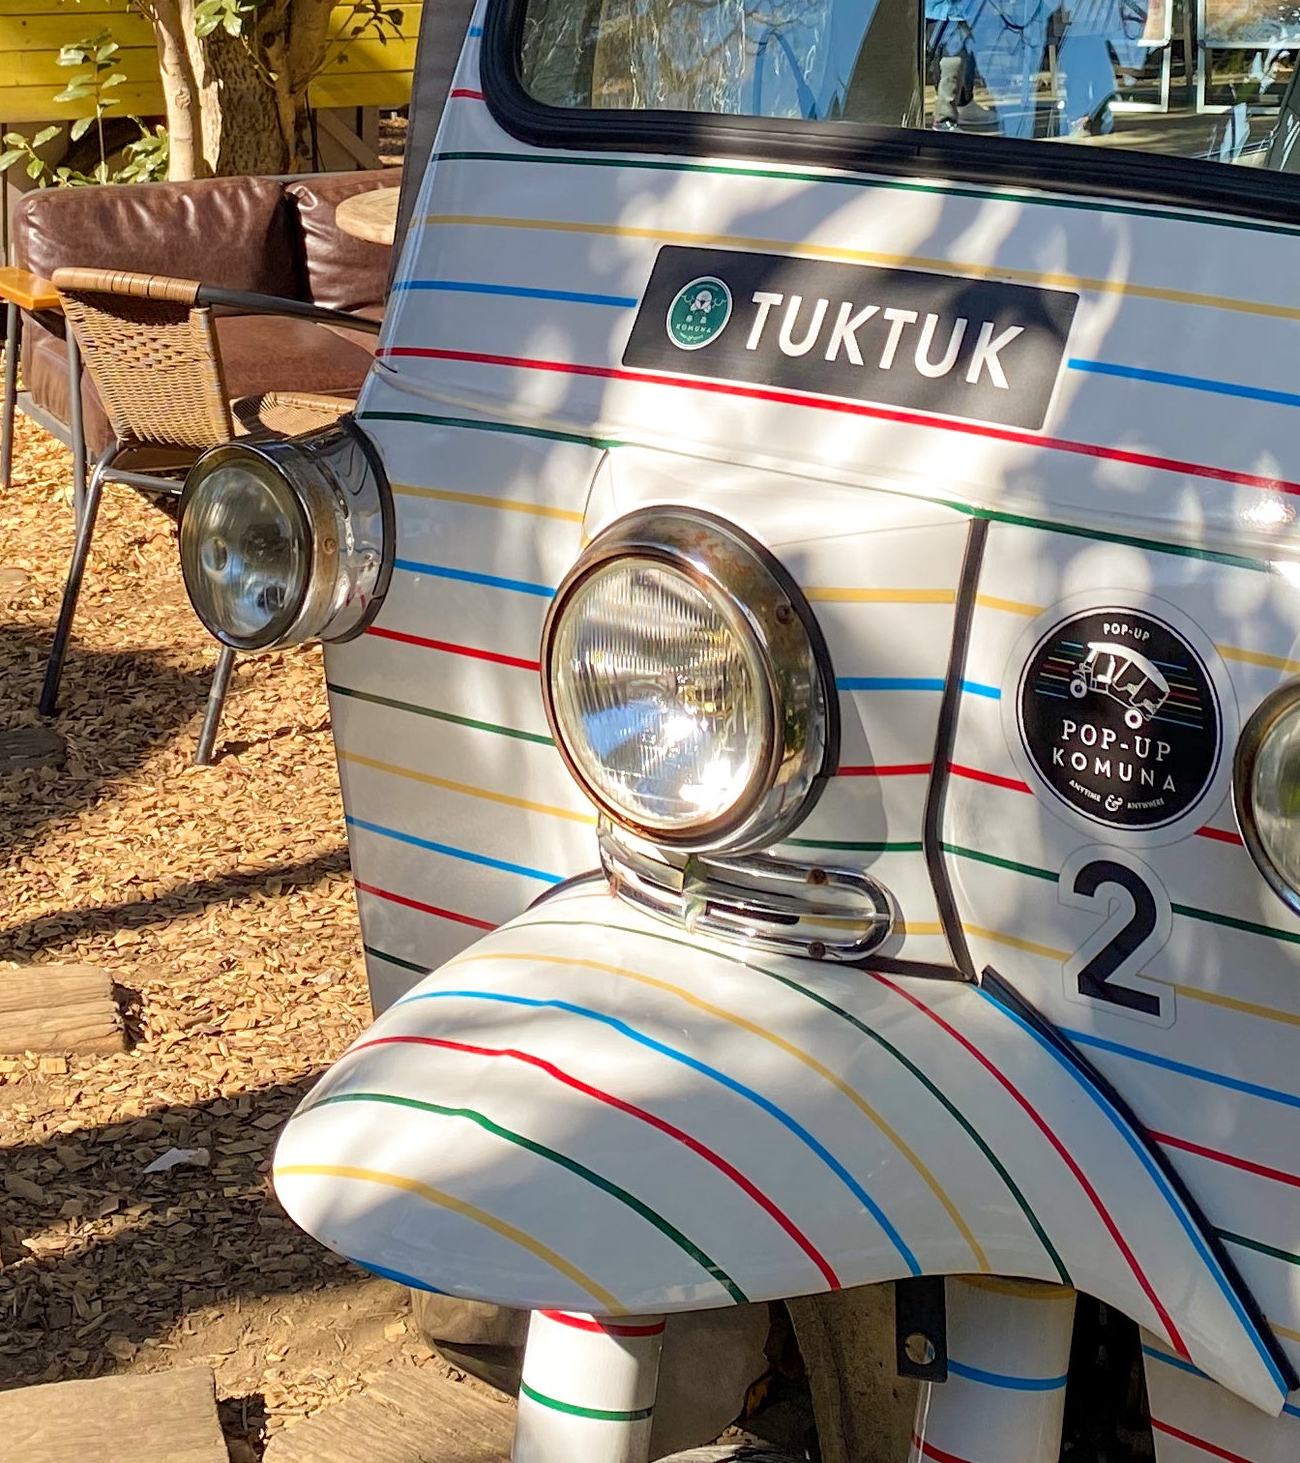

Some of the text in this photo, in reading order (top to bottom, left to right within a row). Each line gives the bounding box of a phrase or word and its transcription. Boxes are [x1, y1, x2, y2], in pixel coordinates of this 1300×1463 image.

[745, 290, 1025, 390] TUKTUK
[1102, 622, 1150, 641] POP-UP
[1060, 719, 1171, 762] POP-UP
[1052, 746, 1176, 793] KOMUNA
[1068, 779, 1102, 803] ANYTIME
[1104, 794, 1124, 812] &
[1073, 859, 1161, 1017] 2
